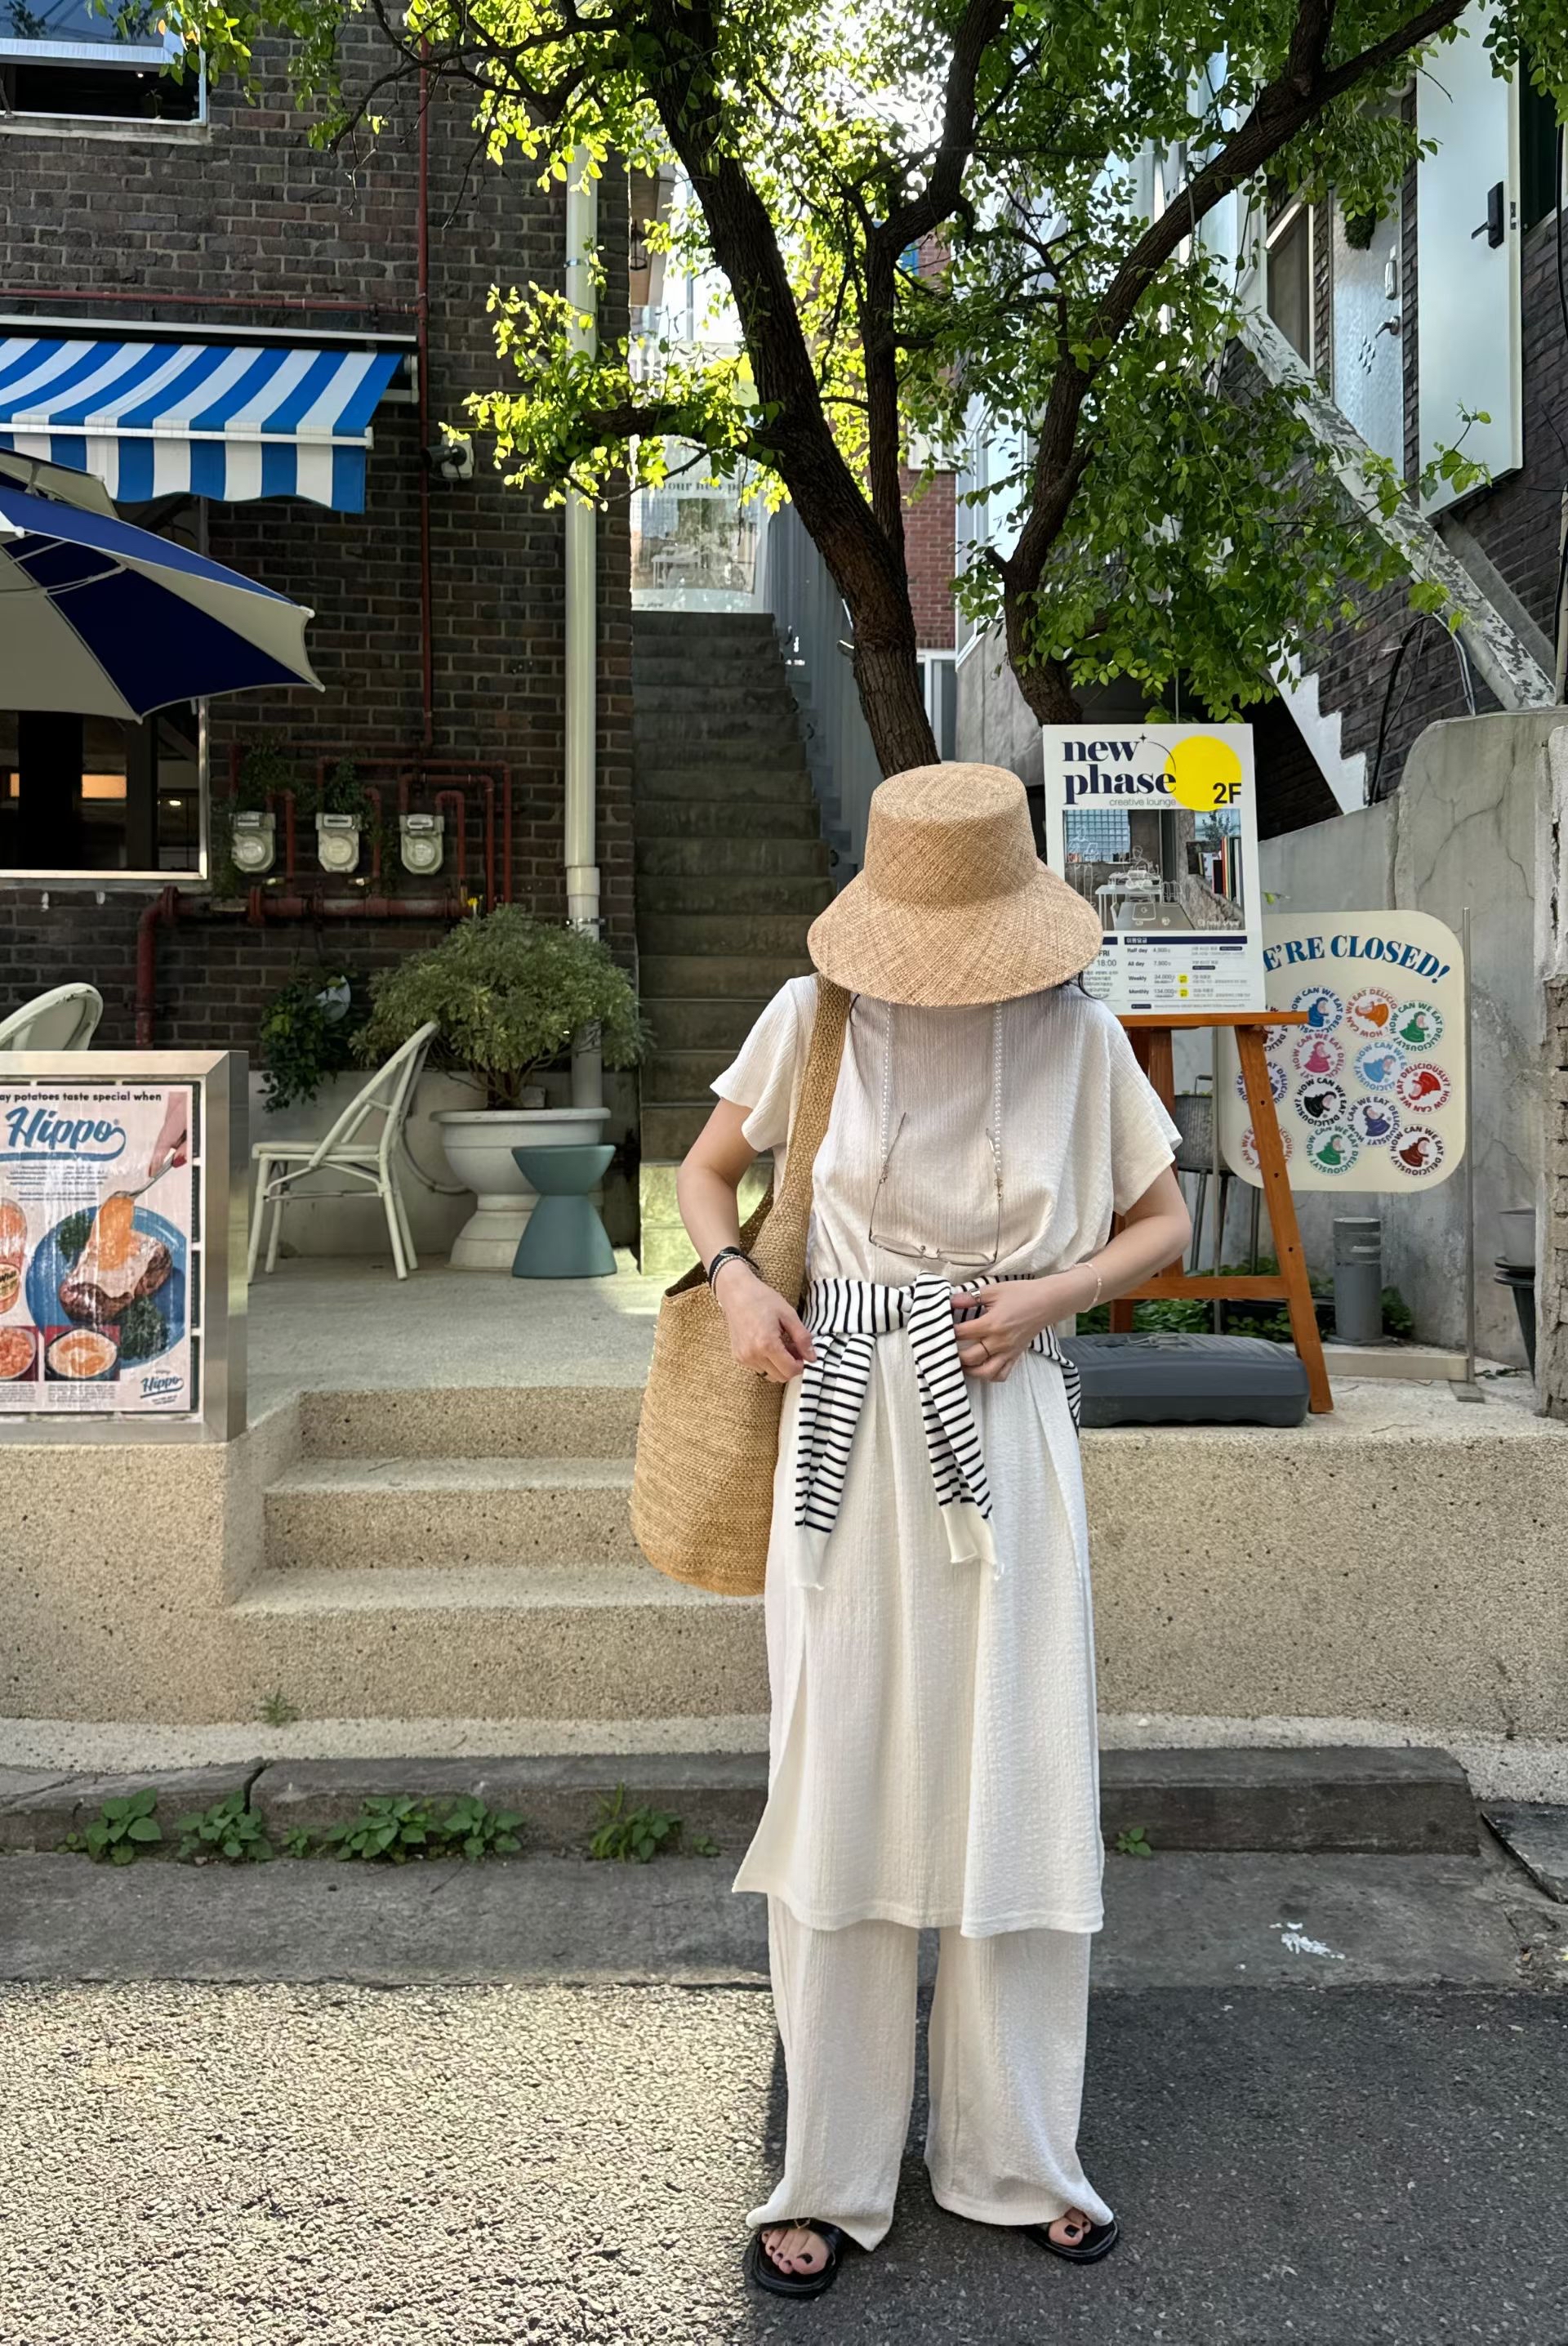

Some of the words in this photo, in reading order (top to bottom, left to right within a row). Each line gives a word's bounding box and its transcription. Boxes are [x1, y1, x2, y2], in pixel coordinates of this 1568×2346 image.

[1062, 742, 1139, 761] new
[1062, 764, 1176, 805] phase
[1213, 783, 1241, 804] 2F
[1147, 798, 1176, 807] lounge
[1330, 934, 1450, 983] CLOSED!
[1291, 996, 1302, 1011] OW
[1302, 988, 1319, 996] CAN
[1322, 988, 1335, 998] WE
[1334, 998, 1343, 1013] EAT
[1352, 989, 1366, 1001] EAT
[1346, 1001, 1355, 1014] WE
[1347, 1016, 1359, 1032] CAN
[1389, 1013, 1399, 1033] HOW
[1398, 1002, 1415, 1013] CAN
[1419, 1002, 1432, 1012] WE
[1432, 1010, 1442, 1025] EAT
[1293, 1049, 1301, 1069] HOW
[1297, 1034, 1312, 1047] CAN
[1329, 1037, 1342, 1050] EAT
[1356, 1045, 1372, 1062] HOW
[1393, 1047, 1405, 1060] WE
[1317, 1077, 1334, 1086] CAN
[1400, 1063, 1450, 1086] DELICIOUSLY?
[1297, 1078, 1314, 1095] HOW
[1334, 1085, 1346, 1098] WE
[14, 1092, 60, 1102] potatoes
[63, 1092, 90, 1101] taste
[93, 1091, 130, 1102] special
[134, 1091, 162, 1101] when
[1399, 1095, 1412, 1108] WE
[1434, 1090, 1450, 1109] HOW
[1294, 1099, 1340, 1126] DELICIOUSLY?
[1339, 1099, 1347, 1115] EAT
[1348, 1105, 1358, 1122] CAN
[1356, 1097, 1372, 1105] WE
[1374, 1096, 1389, 1105] EAT
[1414, 1104, 1432, 1113] CAN
[5, 1106, 126, 1151] Hippo
[1424, 1128, 1438, 1140] WE
[1307, 1135, 1316, 1156] HOW
[1334, 1125, 1348, 1135] WE
[1347, 1134, 1358, 1148] EAT
[1389, 1131, 1403, 1152] HOW
[1435, 1140, 1444, 1155] EAT
[1391, 1156, 1441, 1175] DELICIOUSLY?
[140, 1376, 181, 1392] Hippo
